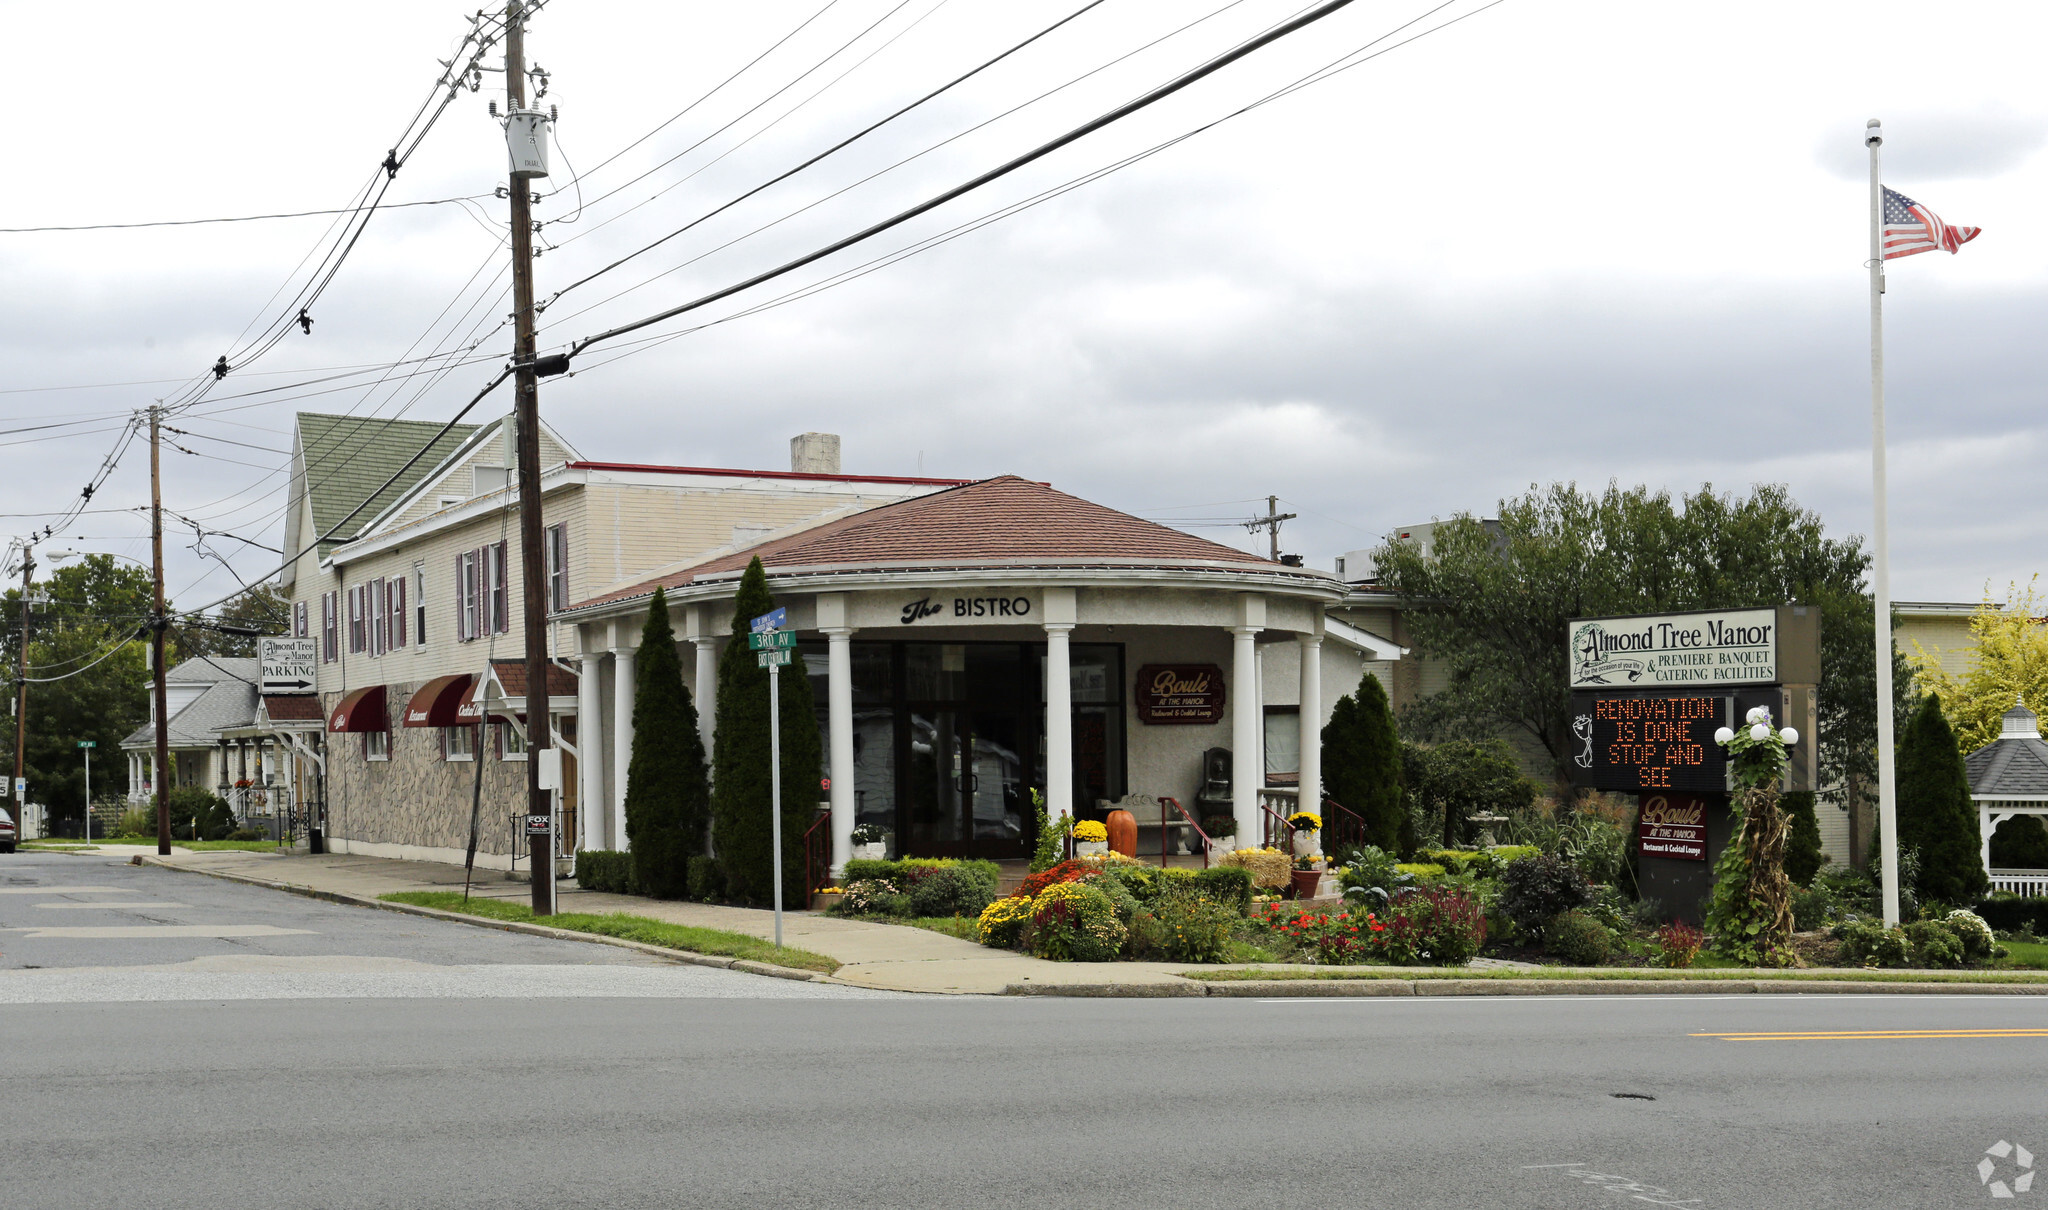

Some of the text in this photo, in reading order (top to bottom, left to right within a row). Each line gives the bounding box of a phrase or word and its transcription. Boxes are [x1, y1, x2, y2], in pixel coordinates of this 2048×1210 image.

[901, 597, 1031, 625] The BISTRO
[269, 641, 313, 653] Almond Tree
[756, 633, 789, 647] 3RD AV
[1587, 620, 1772, 661] Almond Tree Manor
[292, 651, 313, 660] Manor
[758, 653, 767, 666] EAST
[1647, 651, 1770, 673] & PREMIERE BANQUET
[262, 666, 314, 676] PARKING
[1598, 663, 1618, 672] occasion
[1623, 663, 1632, 671] your
[1656, 666, 1773, 681] CATERING FACILITIES
[1158, 698, 1166, 706] AT
[1181, 697, 1205, 705] MANOR
[1596, 698, 1714, 720] RENOVATION
[1616, 721, 1692, 742] IS DONE
[1609, 744, 1703, 765] STOP AND
[1639, 767, 1671, 787] SEE
[1650, 828, 1697, 839] AT THE MANOR
[1643, 842, 1701, 857] Restaurant & Cocktail Lounge
